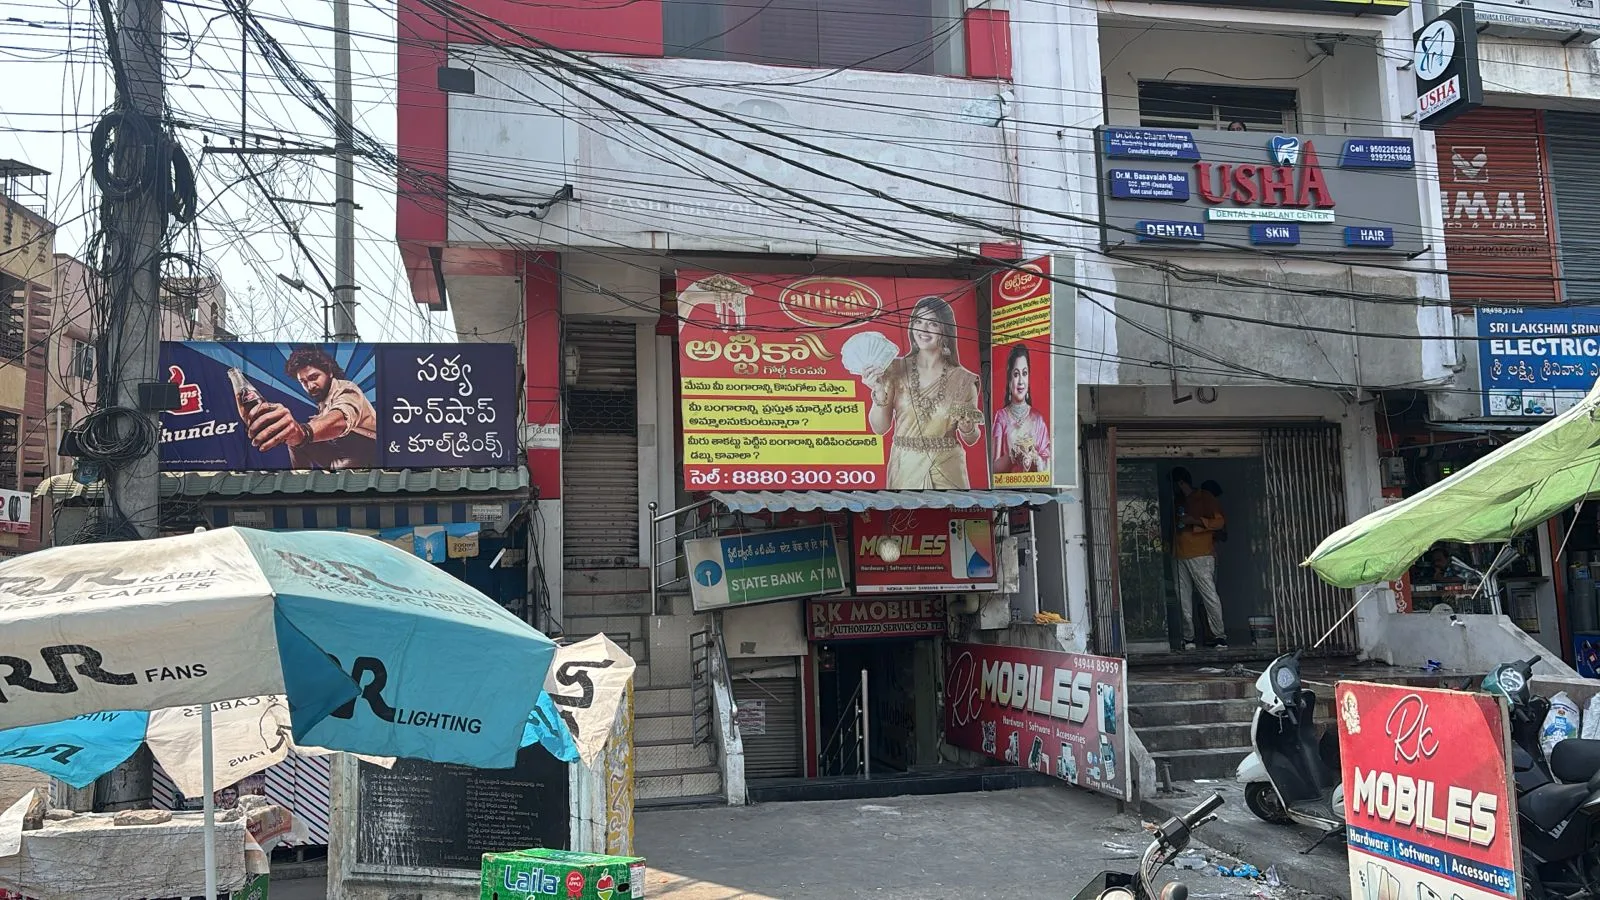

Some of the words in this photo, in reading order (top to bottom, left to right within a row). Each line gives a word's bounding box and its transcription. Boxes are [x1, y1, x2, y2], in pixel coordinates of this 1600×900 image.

[1420, 79, 1456, 111] USHA
[1350, 144, 1364, 153] Cell
[1168, 174, 1185, 182] Babu
[1192, 140, 1336, 208] USHA
[1216, 210, 1249, 218] DENTAL
[1258, 210, 1295, 219] IMPLANT
[1296, 211, 1329, 220] CENTER
[1146, 224, 1202, 236] DENTAL
[1266, 228, 1290, 238] SKIN
[1360, 230, 1385, 241] HAIR
[1490, 322, 1508, 332] SRI
[1512, 323, 1568, 334] LAKSHMI
[1572, 324, 1600, 335] SRIN
[416, 354, 474, 396] సత్య
[802, 418, 808, 426] ?
[159, 420, 239, 444] hunder
[388, 440, 400, 452] &
[732, 470, 787, 484] 8880
[790, 470, 832, 484] 300
[836, 470, 876, 484] 300
[1006, 476, 1022, 484] 8880
[1022, 475, 1036, 484] 300
[1036, 474, 1050, 482] 300
[732, 576, 769, 591] STATE
[771, 572, 804, 587] BANK
[87, 582, 212, 602] CABLES
[812, 602, 843, 623] RK
[830, 624, 882, 635] AUTHORIZED
[882, 622, 914, 633] SERVICE
[145, 663, 208, 683] FANS
[1074, 656, 1095, 670] 94944
[1096, 661, 1119, 674] 85959
[980, 659, 1092, 724] MOBILES
[396, 708, 483, 735] LIGHTING
[1002, 715, 1024, 728] Hardware
[1028, 722, 1051, 736] Software
[1056, 727, 1086, 745] Accessories
[1352, 766, 1498, 848] MOBILES
[1350, 829, 1388, 852] Hardware
[1399, 843, 1440, 867] Software
[1452, 858, 1510, 888] Accessories
[504, 865, 561, 894] Laila
